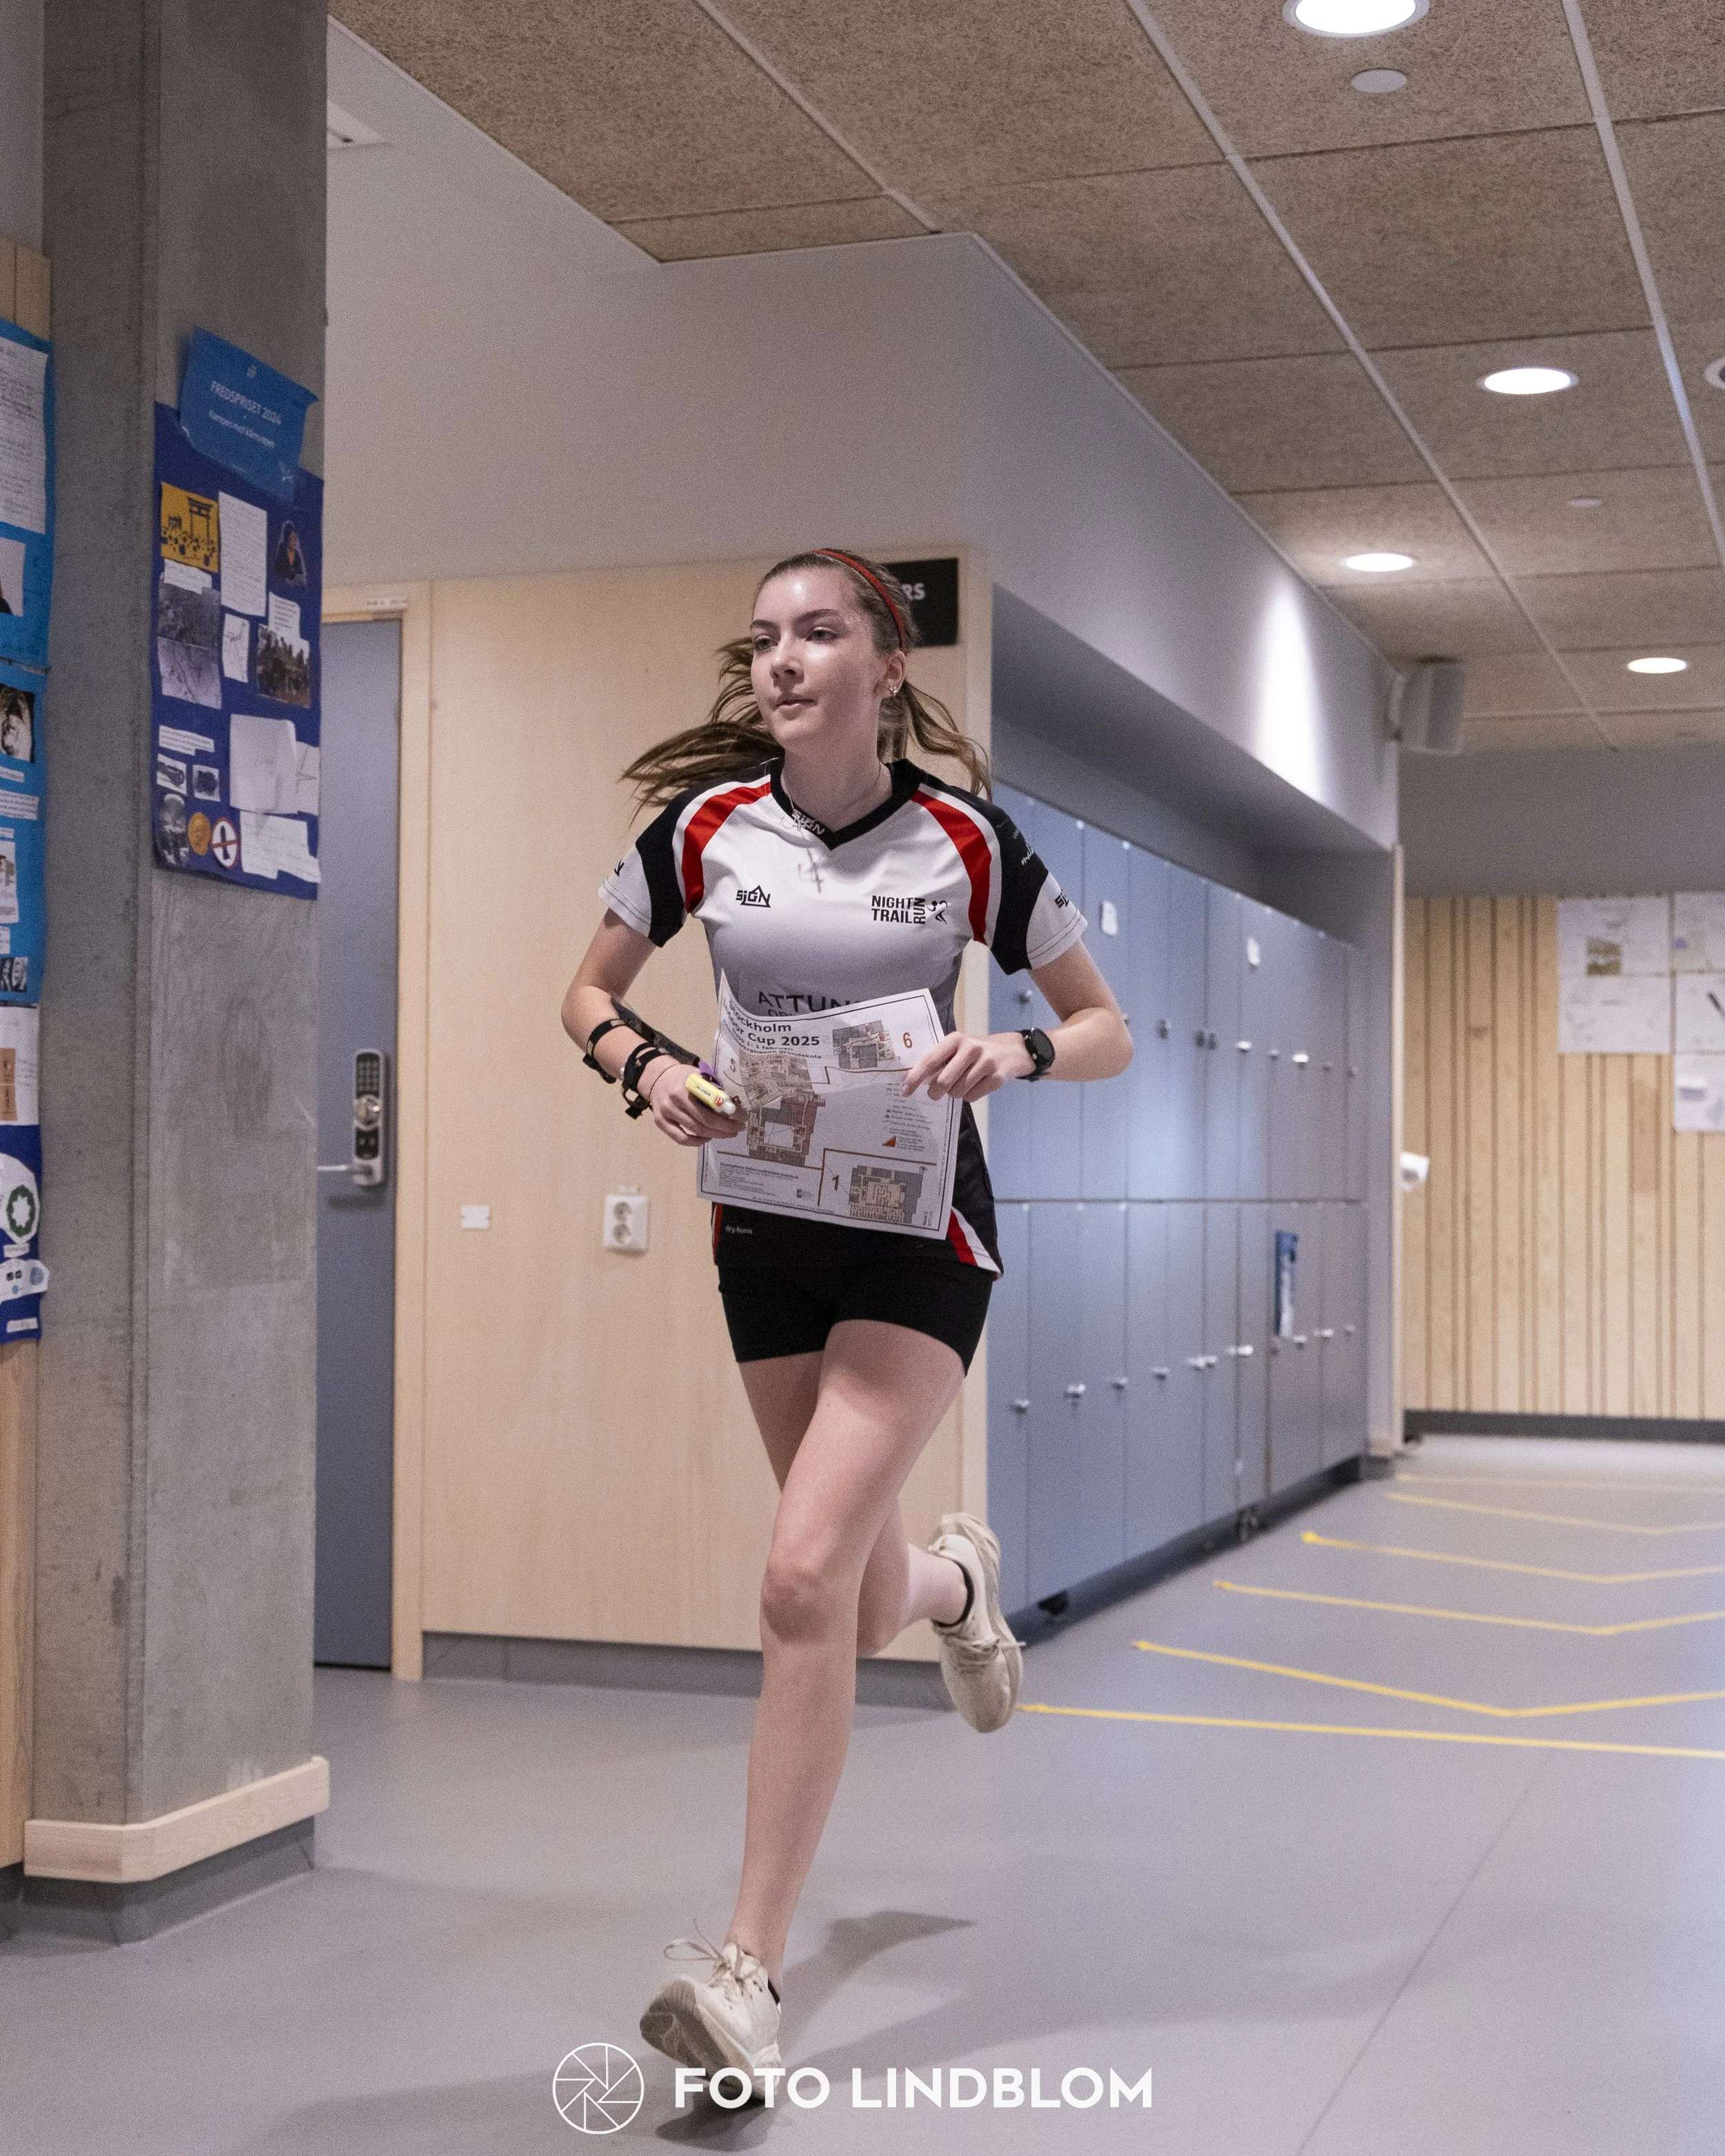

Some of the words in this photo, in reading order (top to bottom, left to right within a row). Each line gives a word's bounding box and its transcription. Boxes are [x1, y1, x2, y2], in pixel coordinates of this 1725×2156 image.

[261, 406, 282, 426] 2024
[871, 896, 914, 909] NIGHT
[913, 897, 926, 924] RUN
[871, 908, 913, 924] TRAIL
[748, 1032, 776, 1046] Cup
[781, 1036, 820, 1046] 2025
[903, 1032, 913, 1049] 6
[730, 1058, 736, 1073] 5
[831, 1174, 840, 1191] 1
